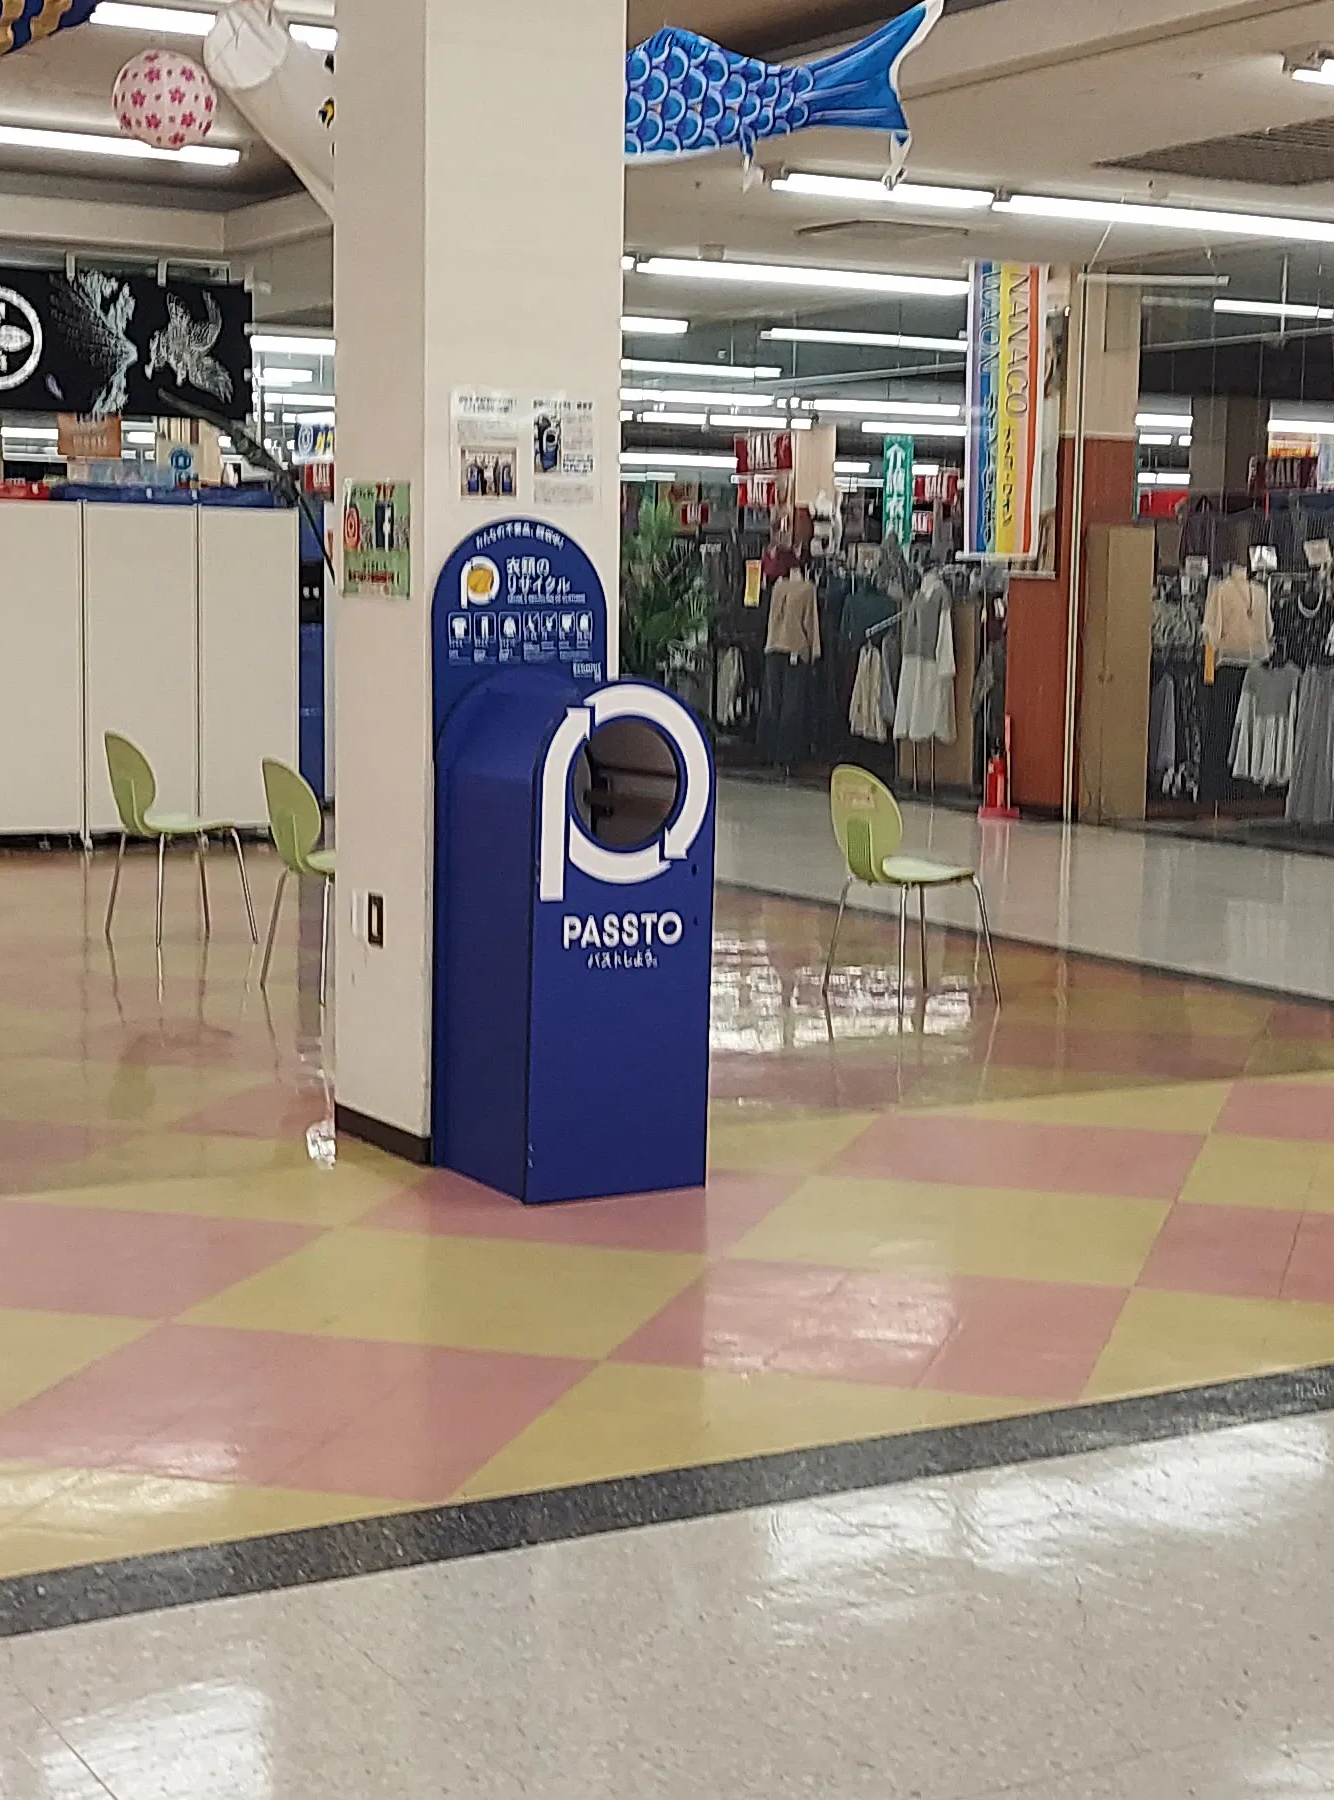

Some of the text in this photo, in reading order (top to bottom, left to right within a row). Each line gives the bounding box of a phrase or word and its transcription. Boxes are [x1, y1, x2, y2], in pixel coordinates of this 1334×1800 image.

[978, 271, 1001, 375] WAON
[1007, 273, 1029, 417] NANACO
[507, 574, 571, 597] リサイクル
[563, 911, 683, 949] PASSTO
